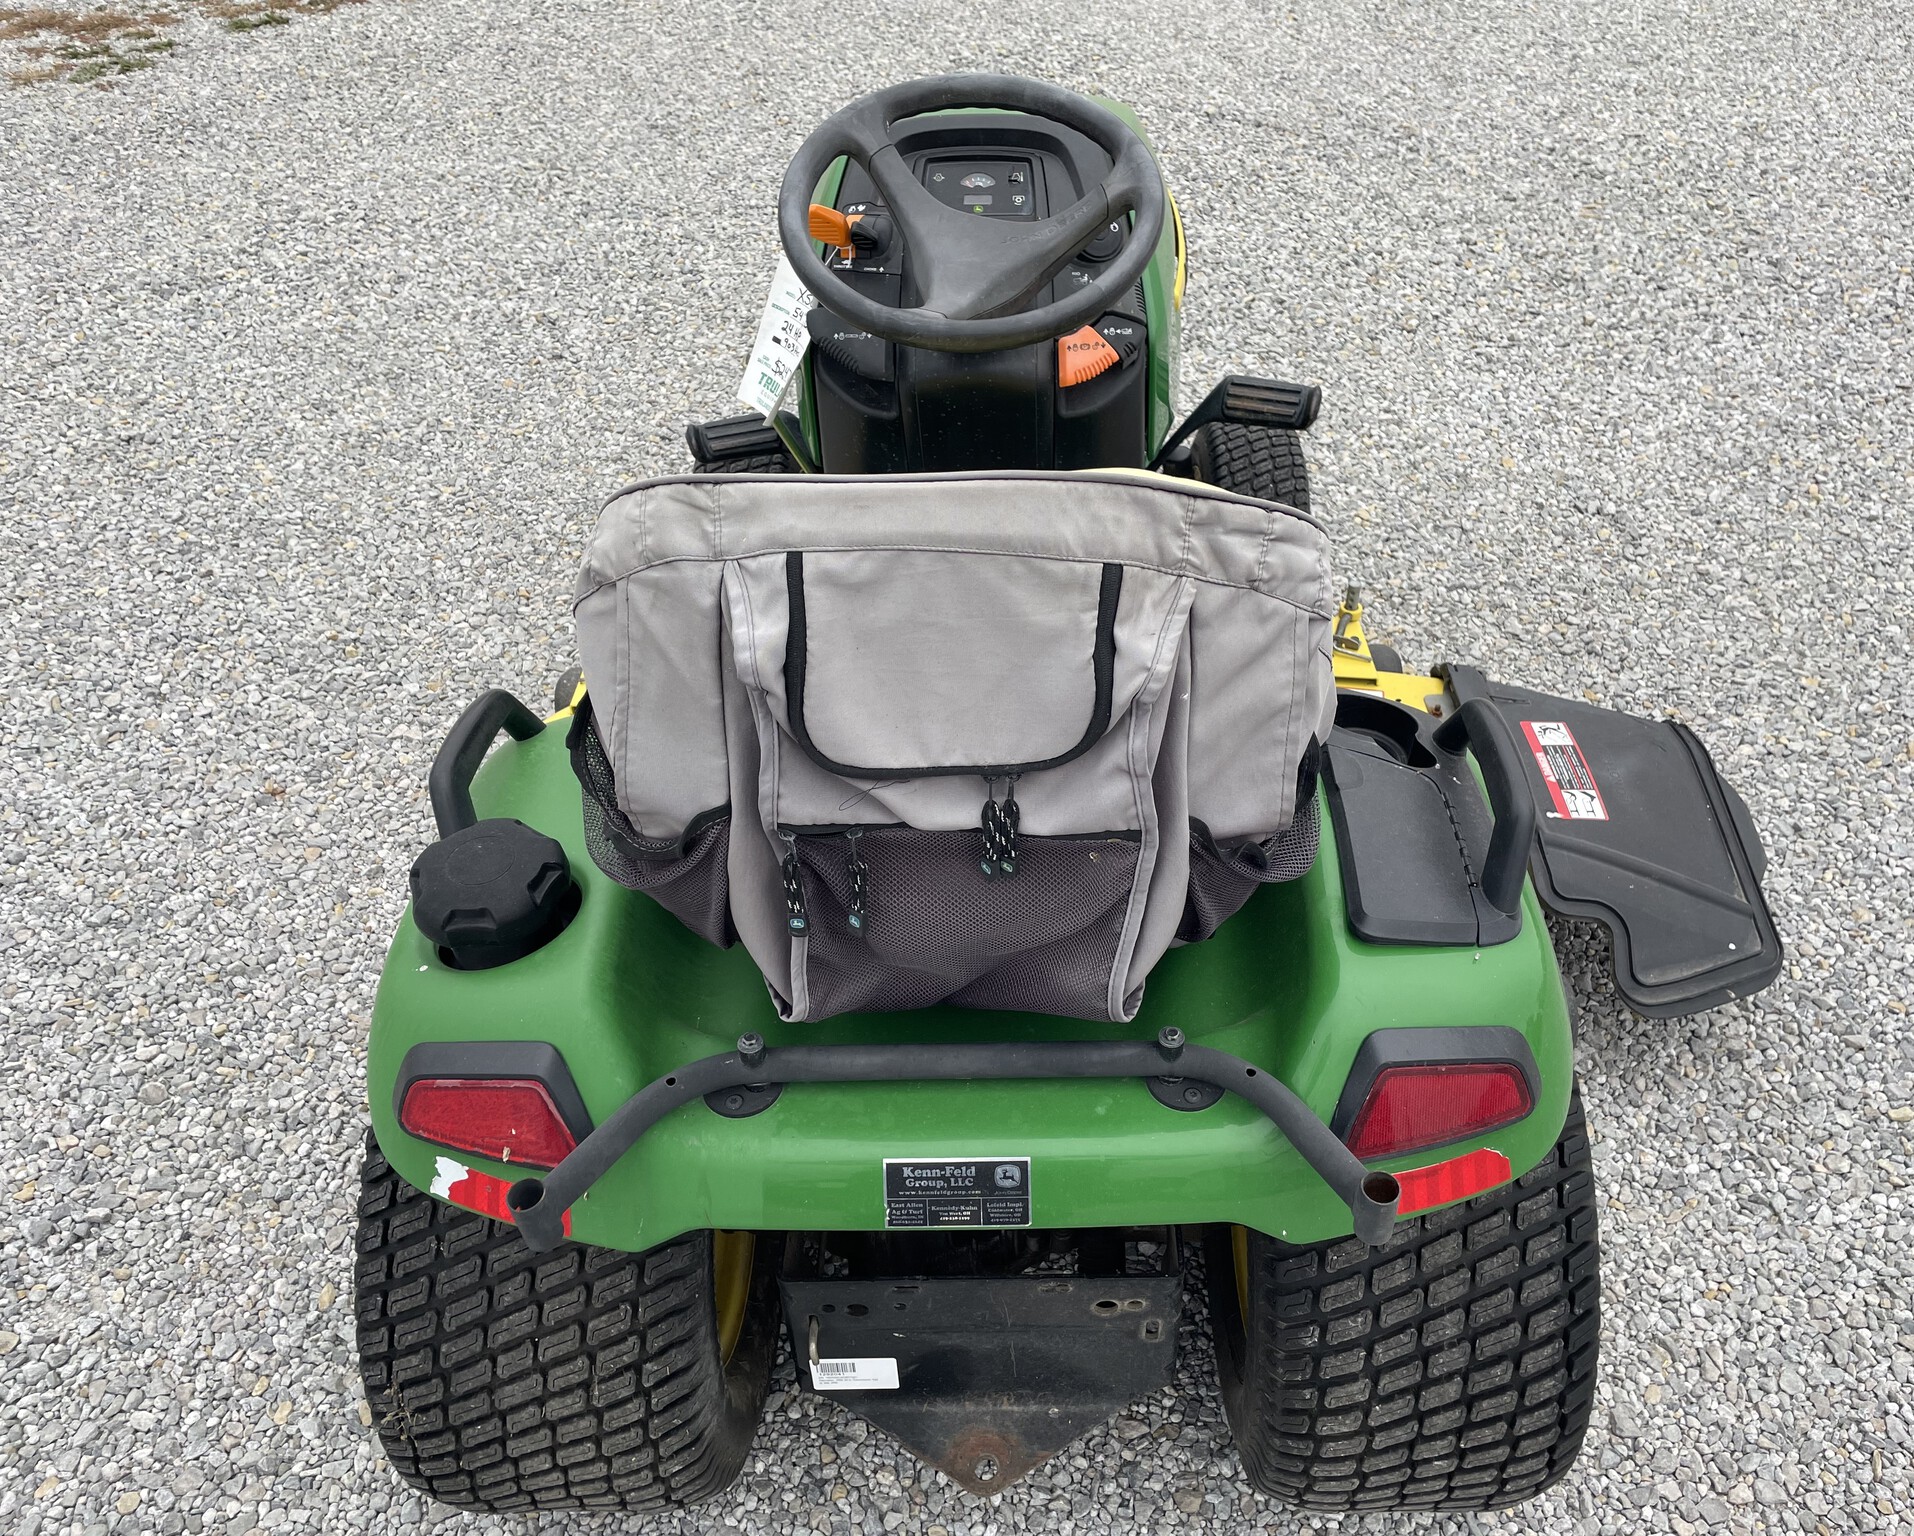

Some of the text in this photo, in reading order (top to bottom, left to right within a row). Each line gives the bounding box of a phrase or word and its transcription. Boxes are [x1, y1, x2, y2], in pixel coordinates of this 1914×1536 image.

[902, 1166, 976, 1178] Kenn-Feld
[905, 1177, 974, 1188] Group, LLC
